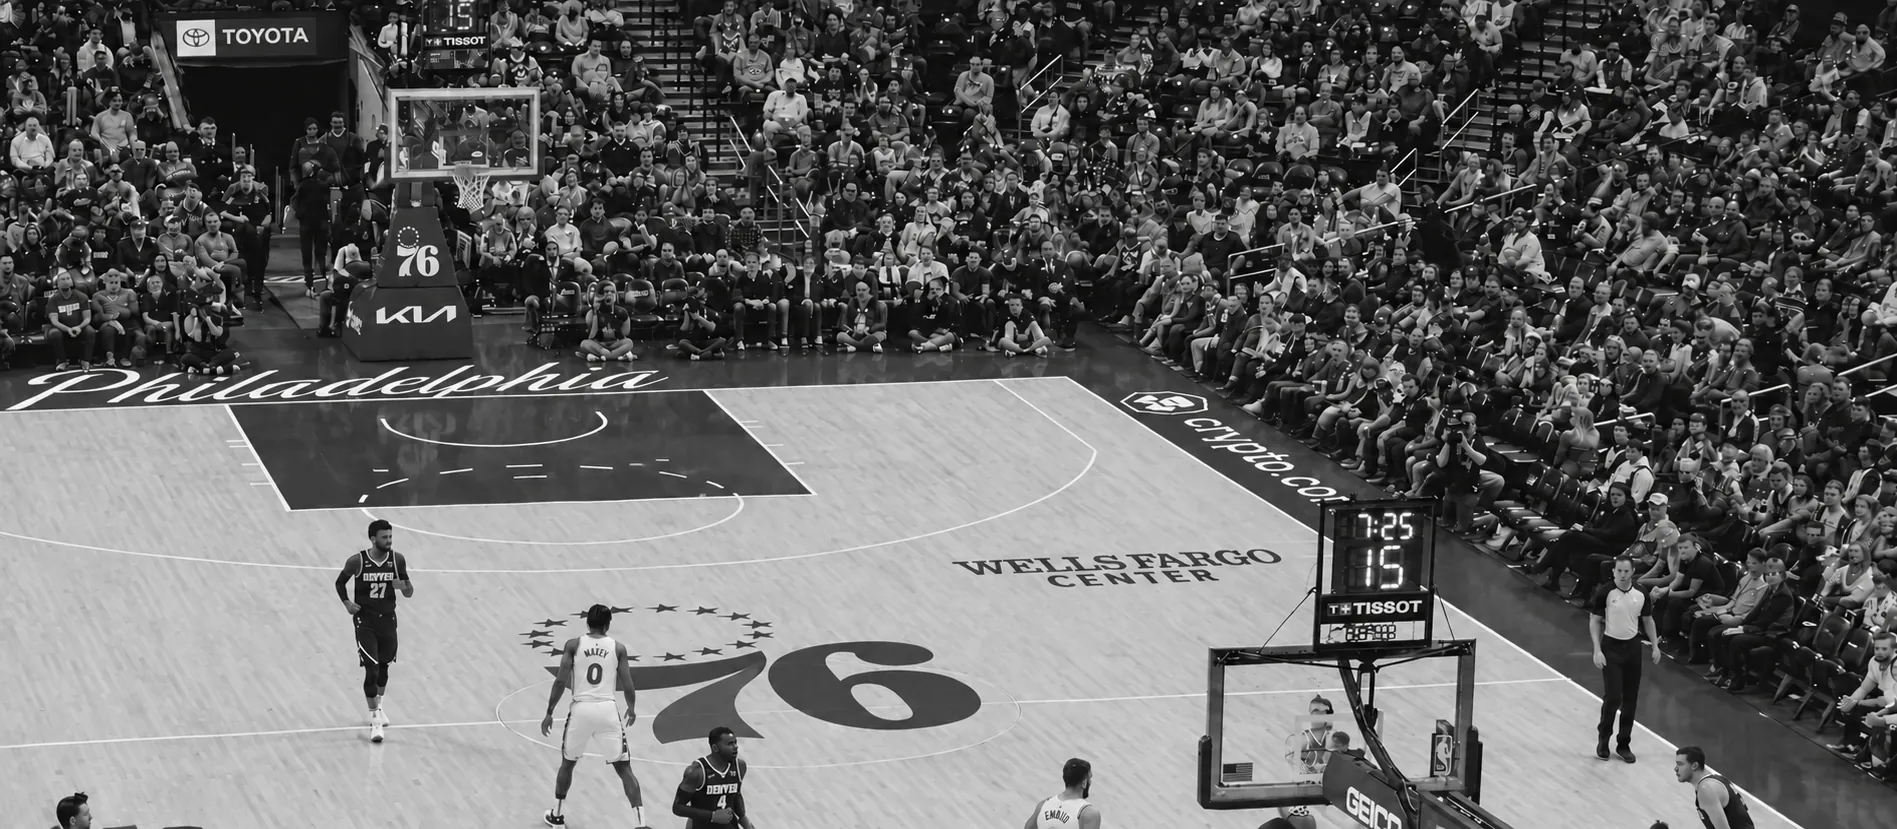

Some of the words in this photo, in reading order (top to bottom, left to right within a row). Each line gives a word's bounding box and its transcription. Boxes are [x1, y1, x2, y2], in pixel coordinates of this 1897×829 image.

[449, 3, 473, 30] 15
[222, 27, 309, 45] TOYOTA
[443, 36, 486, 46] TISSOT
[397, 244, 440, 277] 76
[376, 305, 456, 325] KIA
[5, 361, 669, 411] Philadelphia
[1357, 512, 1413, 541] 7:25
[952, 553, 1128, 576] WELLS
[1125, 548, 1282, 570] FARGO
[1365, 544, 1404, 590] 15
[1047, 569, 1220, 588] CENTER
[369, 582, 387, 599] 27
[1353, 600, 1422, 616] TISSOT
[583, 647, 610, 659] MAXEY
[586, 662, 603, 685] 0
[543, 641, 981, 743] 76
[716, 794, 727, 810] 4
